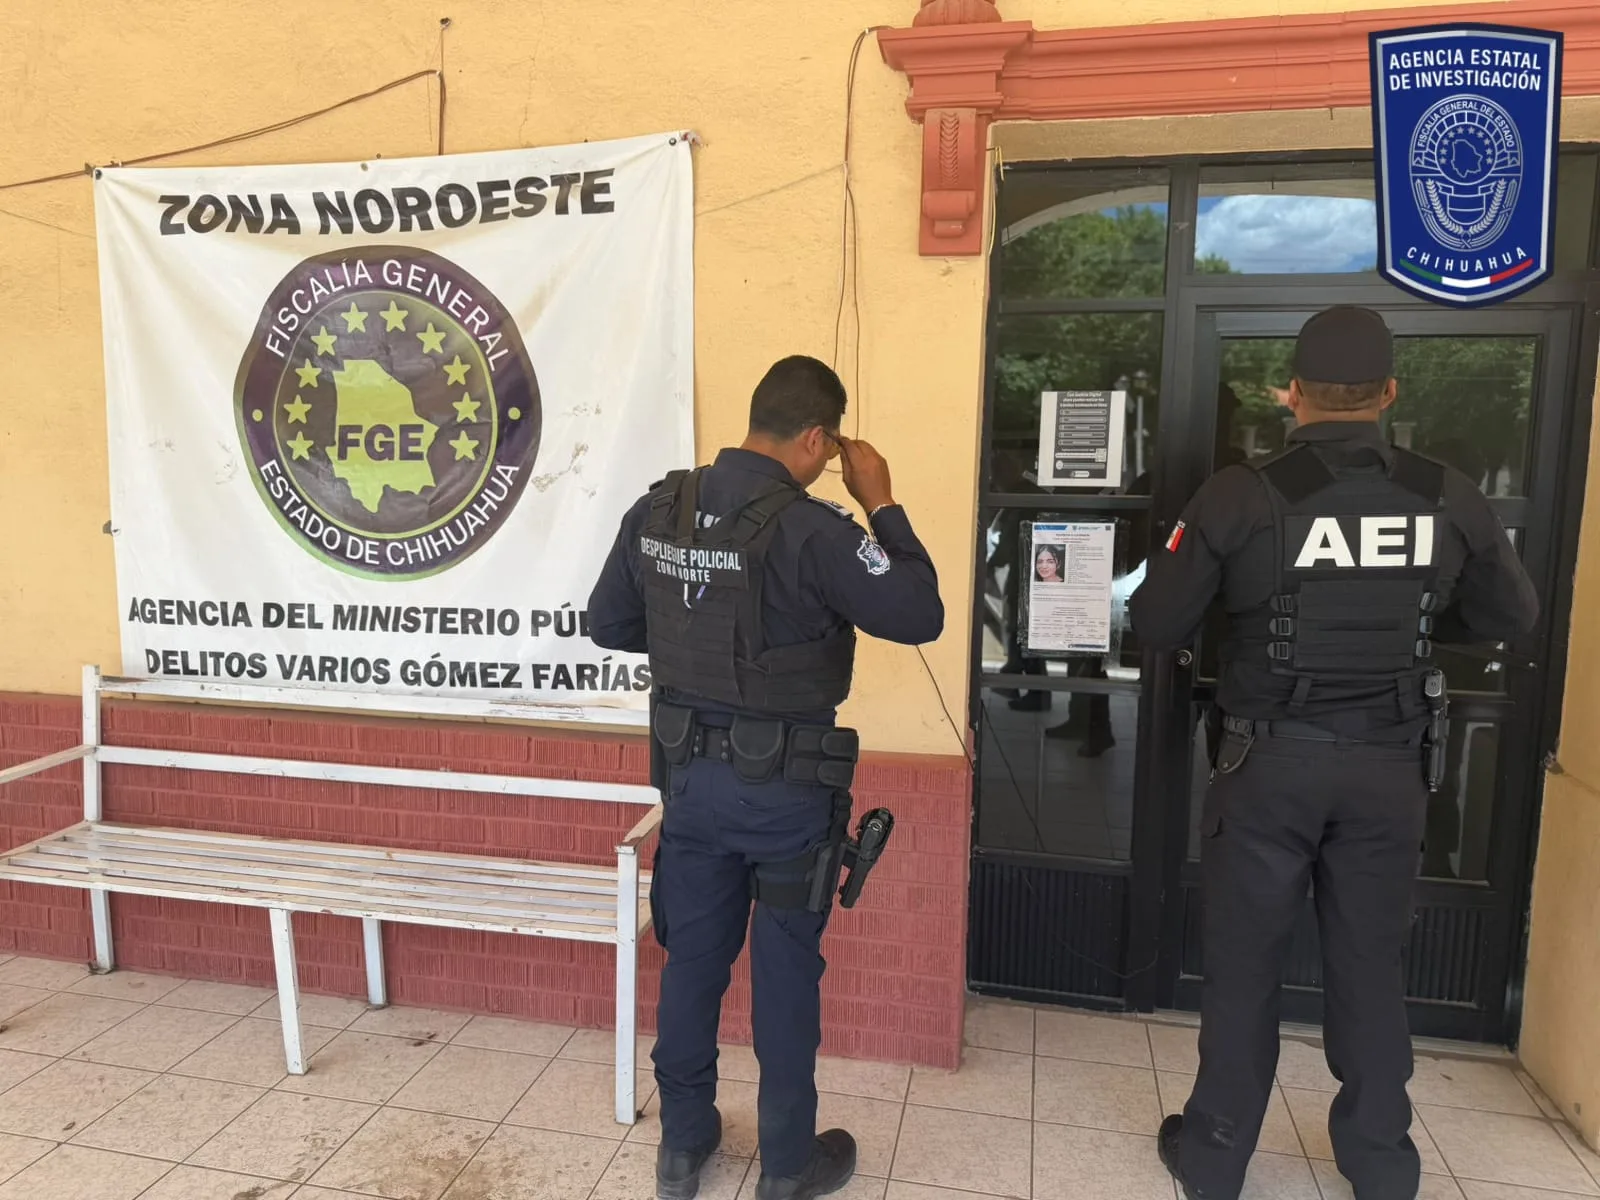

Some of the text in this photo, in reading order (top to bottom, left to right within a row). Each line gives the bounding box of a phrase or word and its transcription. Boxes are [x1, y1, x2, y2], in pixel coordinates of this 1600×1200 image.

[158, 168, 615, 236] ZONA NOROESTE
[265, 258, 509, 371] FISCALÍA GENERAL
[336, 424, 424, 461] FGE
[260, 459, 520, 566] ESTADO DE CHIHUAHUA
[690, 549, 742, 571] POLICIAL
[1294, 515, 1434, 567] AEI
[656, 560, 711, 583] ZONA NORTE
[128, 597, 253, 628] AGENCIA
[261, 601, 322, 631] DEL
[332, 605, 520, 637] MINISTERIO
[145, 649, 651, 691] DELITOS VARIOS GÓMEZ FARÍAS
